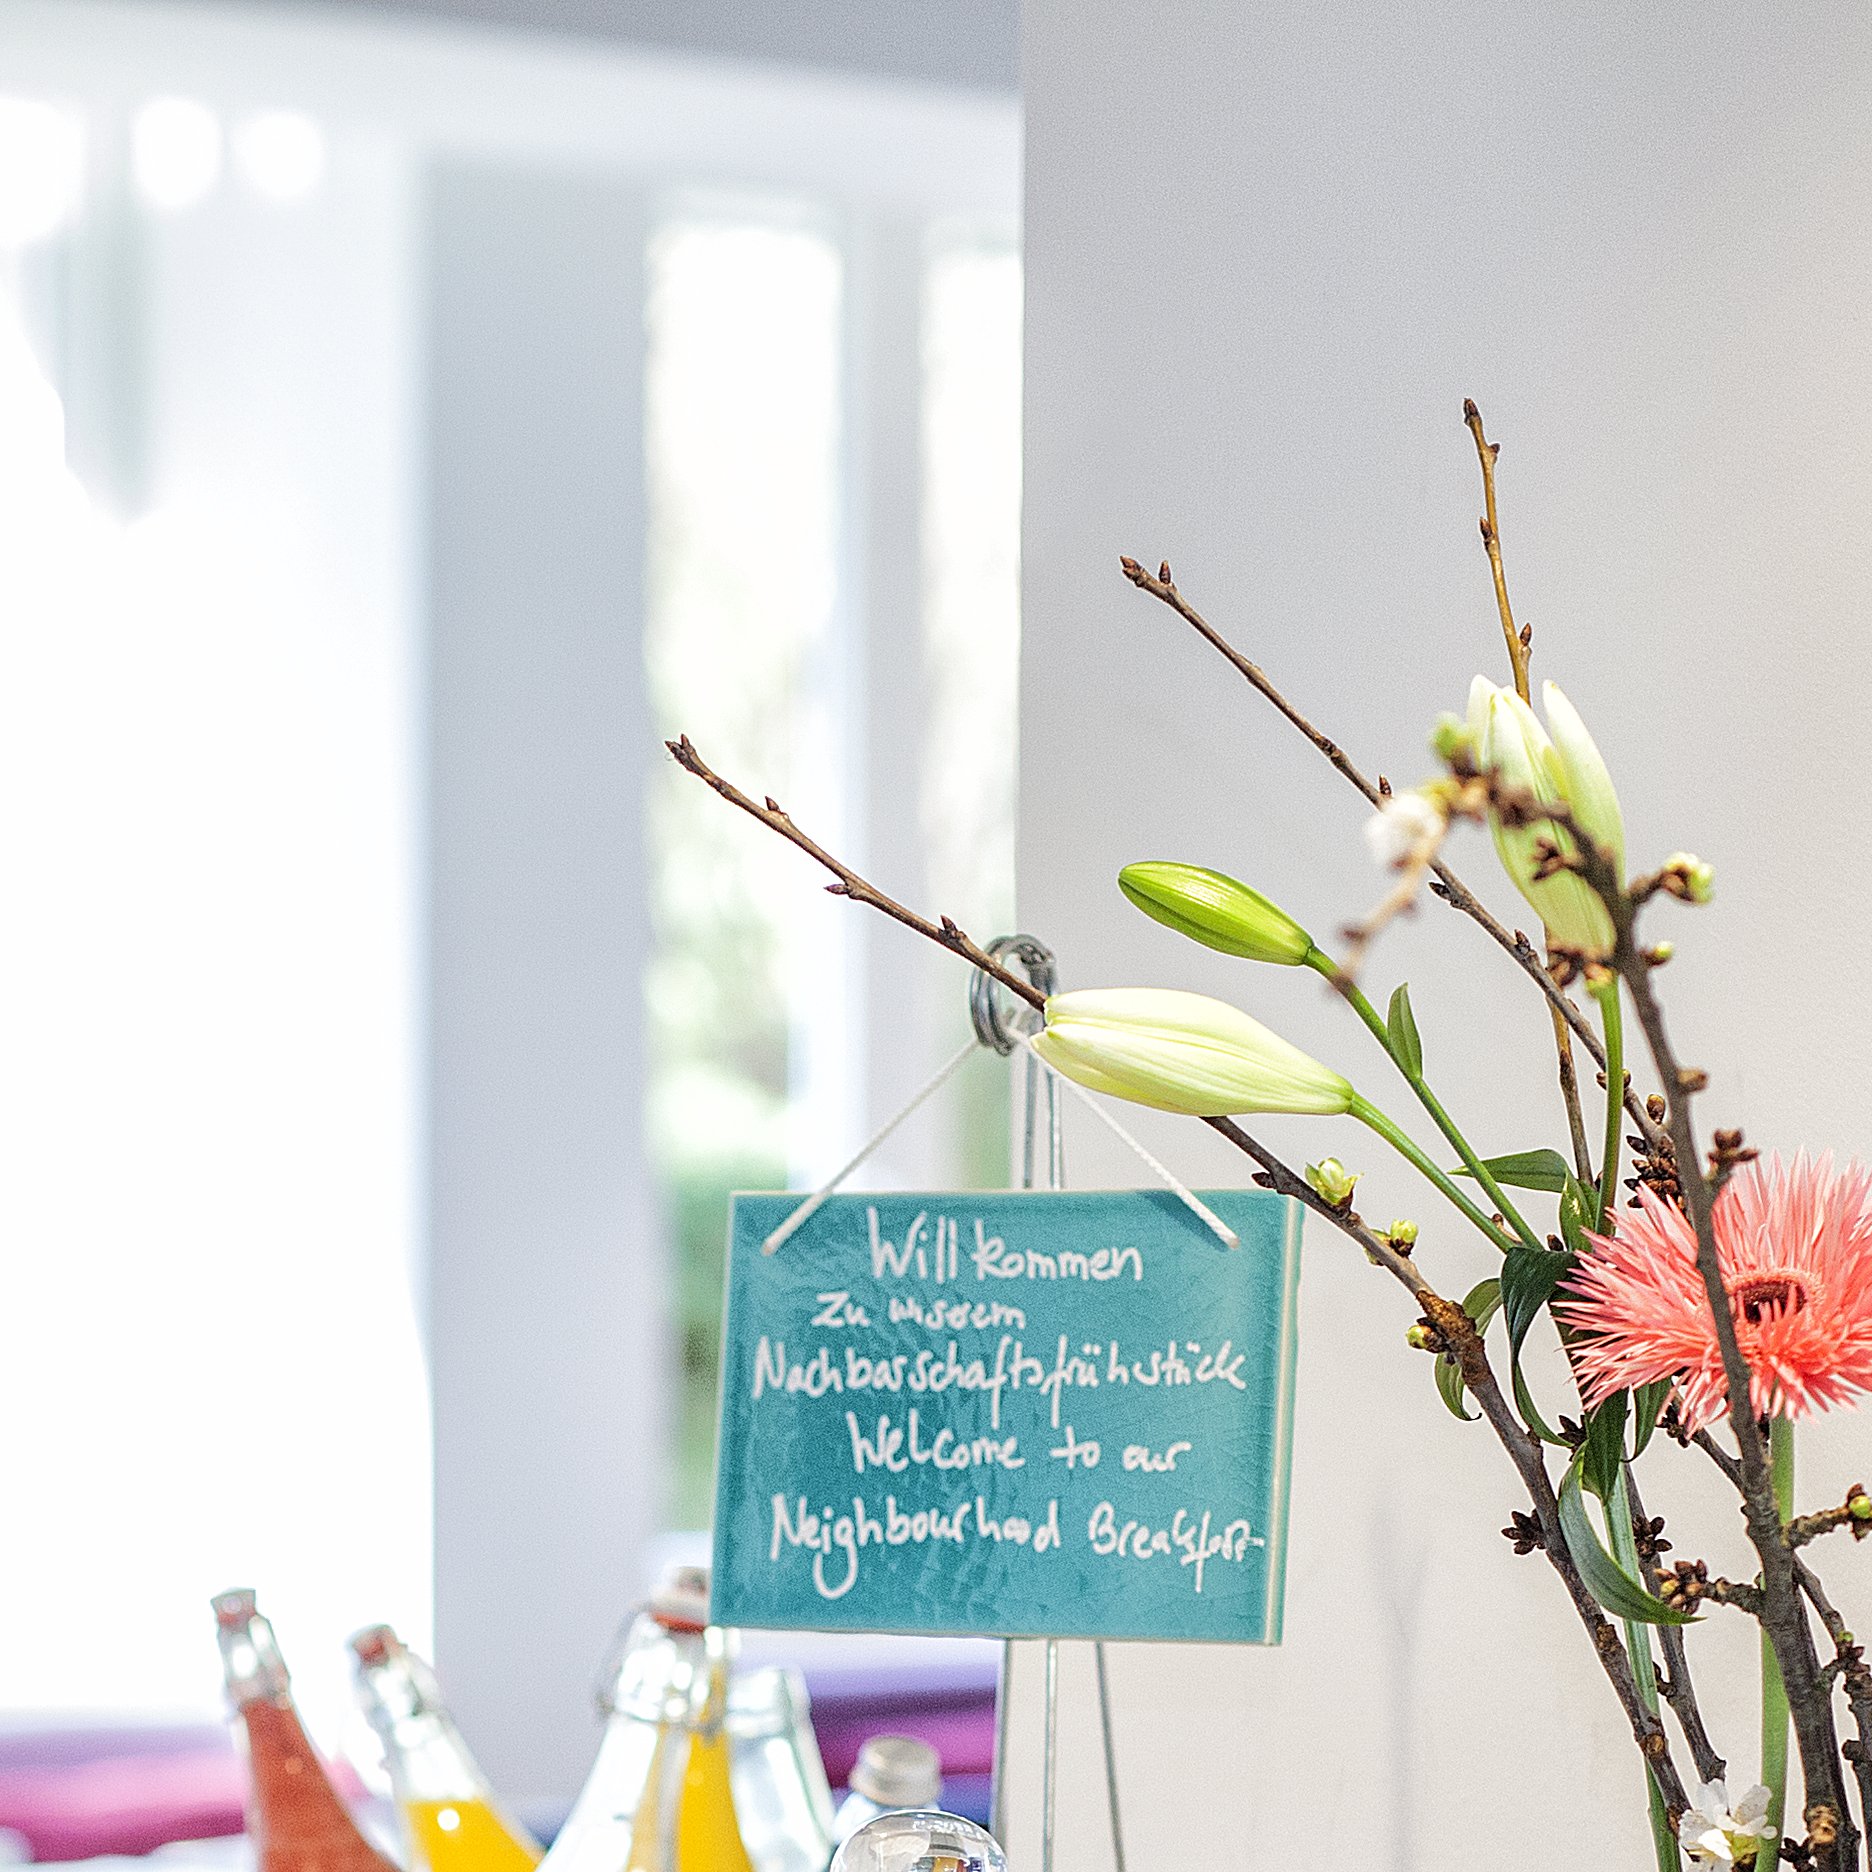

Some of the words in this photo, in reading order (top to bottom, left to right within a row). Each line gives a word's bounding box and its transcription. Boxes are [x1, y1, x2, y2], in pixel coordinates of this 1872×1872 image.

[811, 1291, 870, 1328] Zu
[845, 1407, 1026, 1474] Welcome
[1050, 1425, 1101, 1470] to
[1123, 1441, 1192, 1472] our
[769, 1492, 1062, 1600] Neighbourhood
